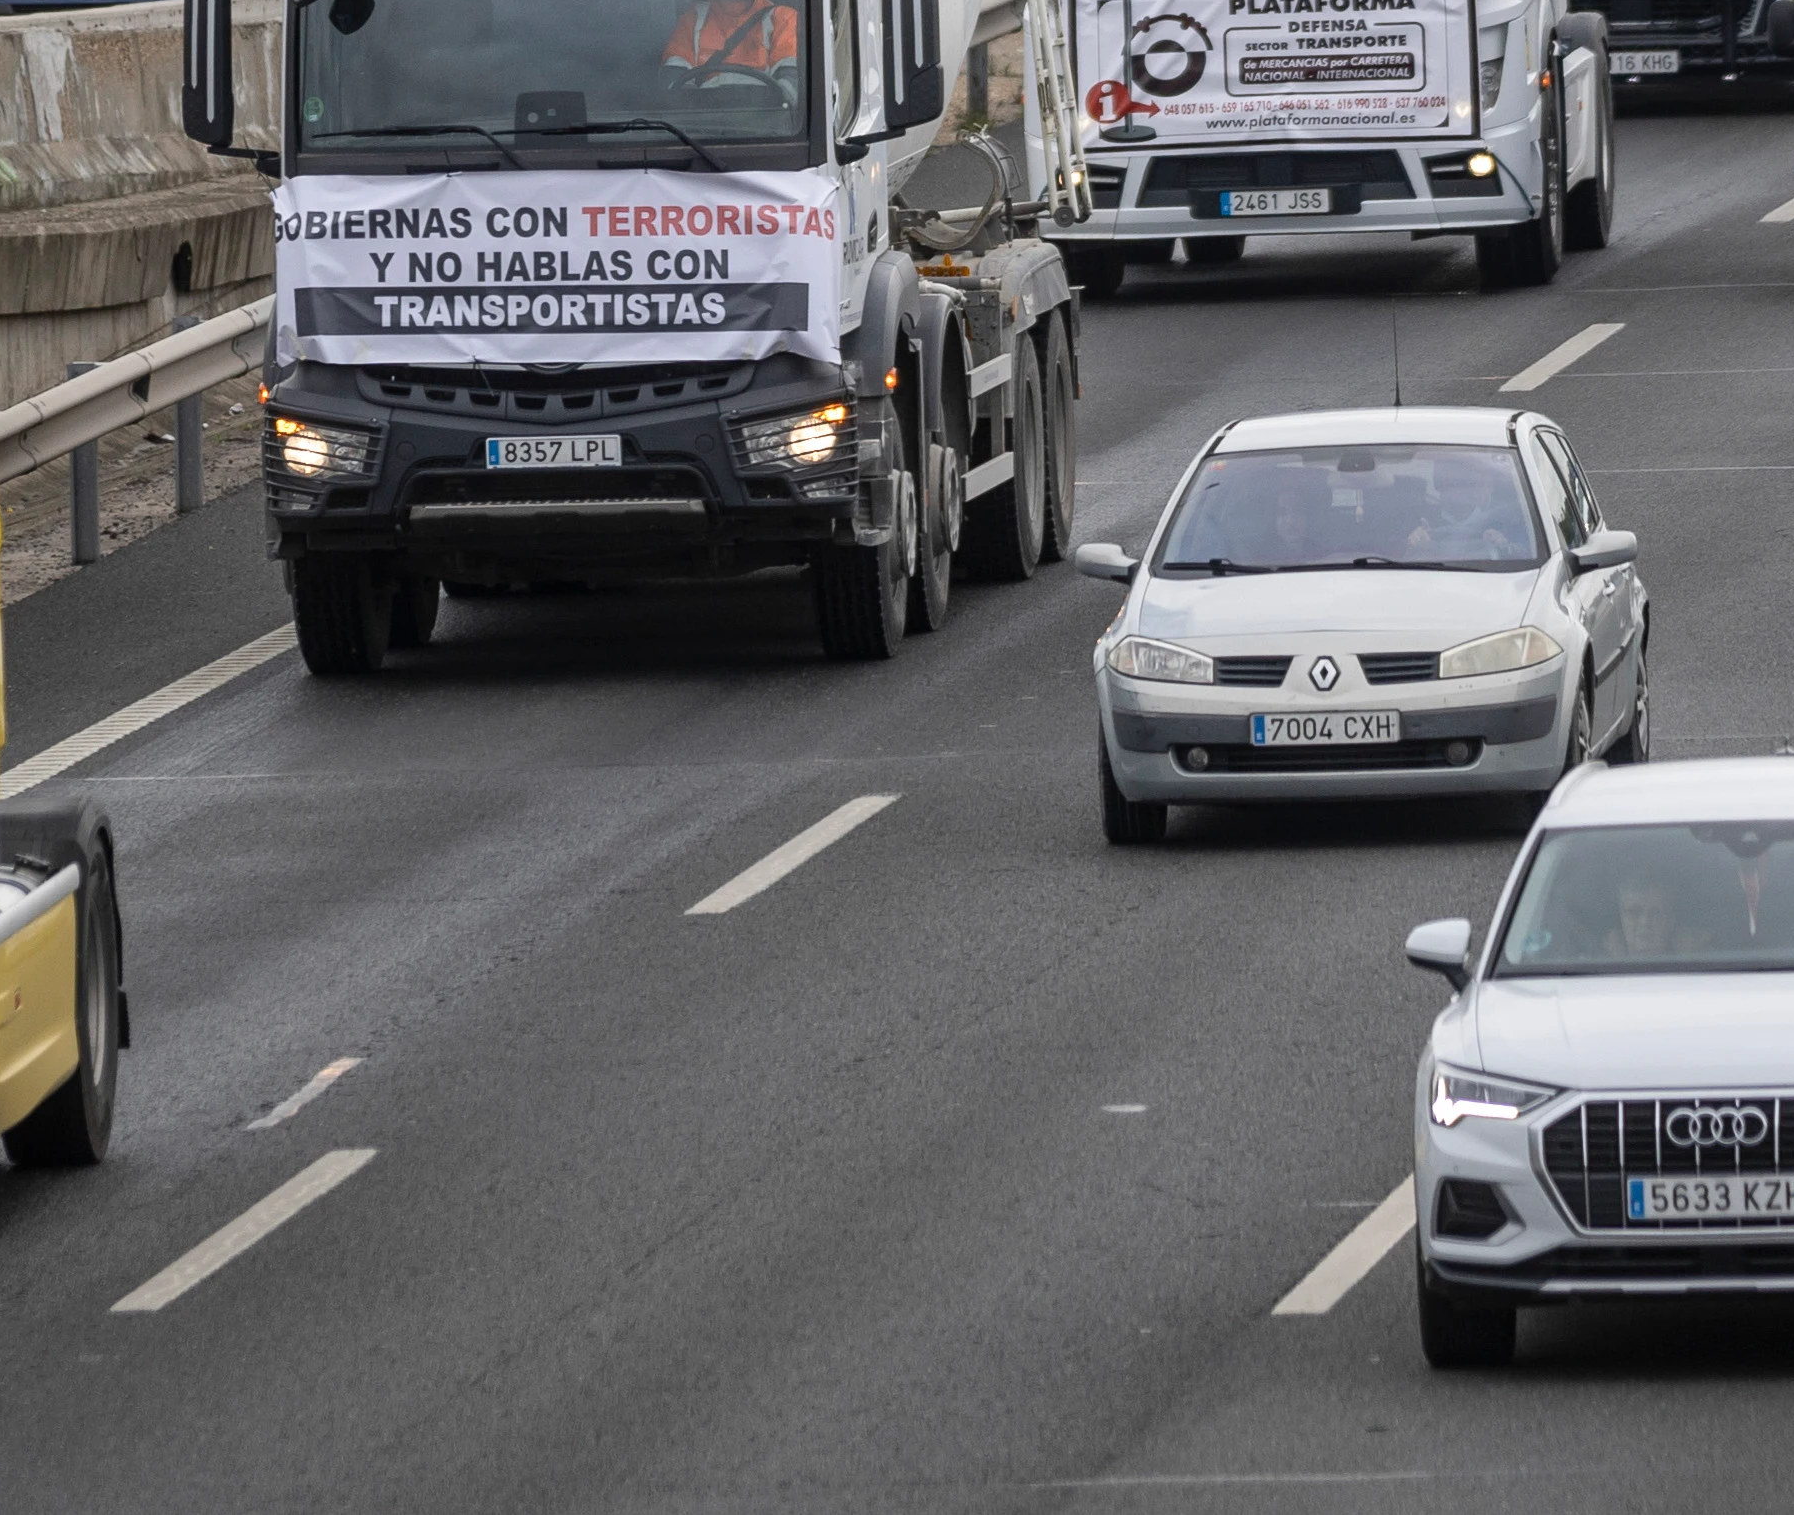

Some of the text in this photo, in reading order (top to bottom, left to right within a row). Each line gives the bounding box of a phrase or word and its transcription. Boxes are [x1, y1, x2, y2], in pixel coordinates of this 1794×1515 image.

[1288, 19, 1368, 33] DEFENSA
[1245, 34, 1407, 52] SECTOR TRANSPORTE
[1244, 54, 1410, 70] de MERCANCIAS por CARRETERA
[1641, 54, 1673, 69] KHG
[1244, 70, 1306, 83] NACIONAL
[1316, 67, 1411, 80] INTERNACIONAL
[1198, 103, 1215, 115] 615
[1221, 102, 1238, 113] 659
[1206, 112, 1416, 131] www.plataformanacional.es
[1234, 191, 1321, 212] 2461 JSS
[486, 206, 568, 238] CON
[582, 204, 835, 240] TERRORISTAS
[369, 248, 730, 282] Y NO HABLAS CON
[373, 292, 726, 328] TRANSPORTISTAS
[504, 440, 615, 463] 8357 LPL
[1271, 714, 1392, 743] 7004 CXH
[1649, 1180, 1732, 1214] 5633
